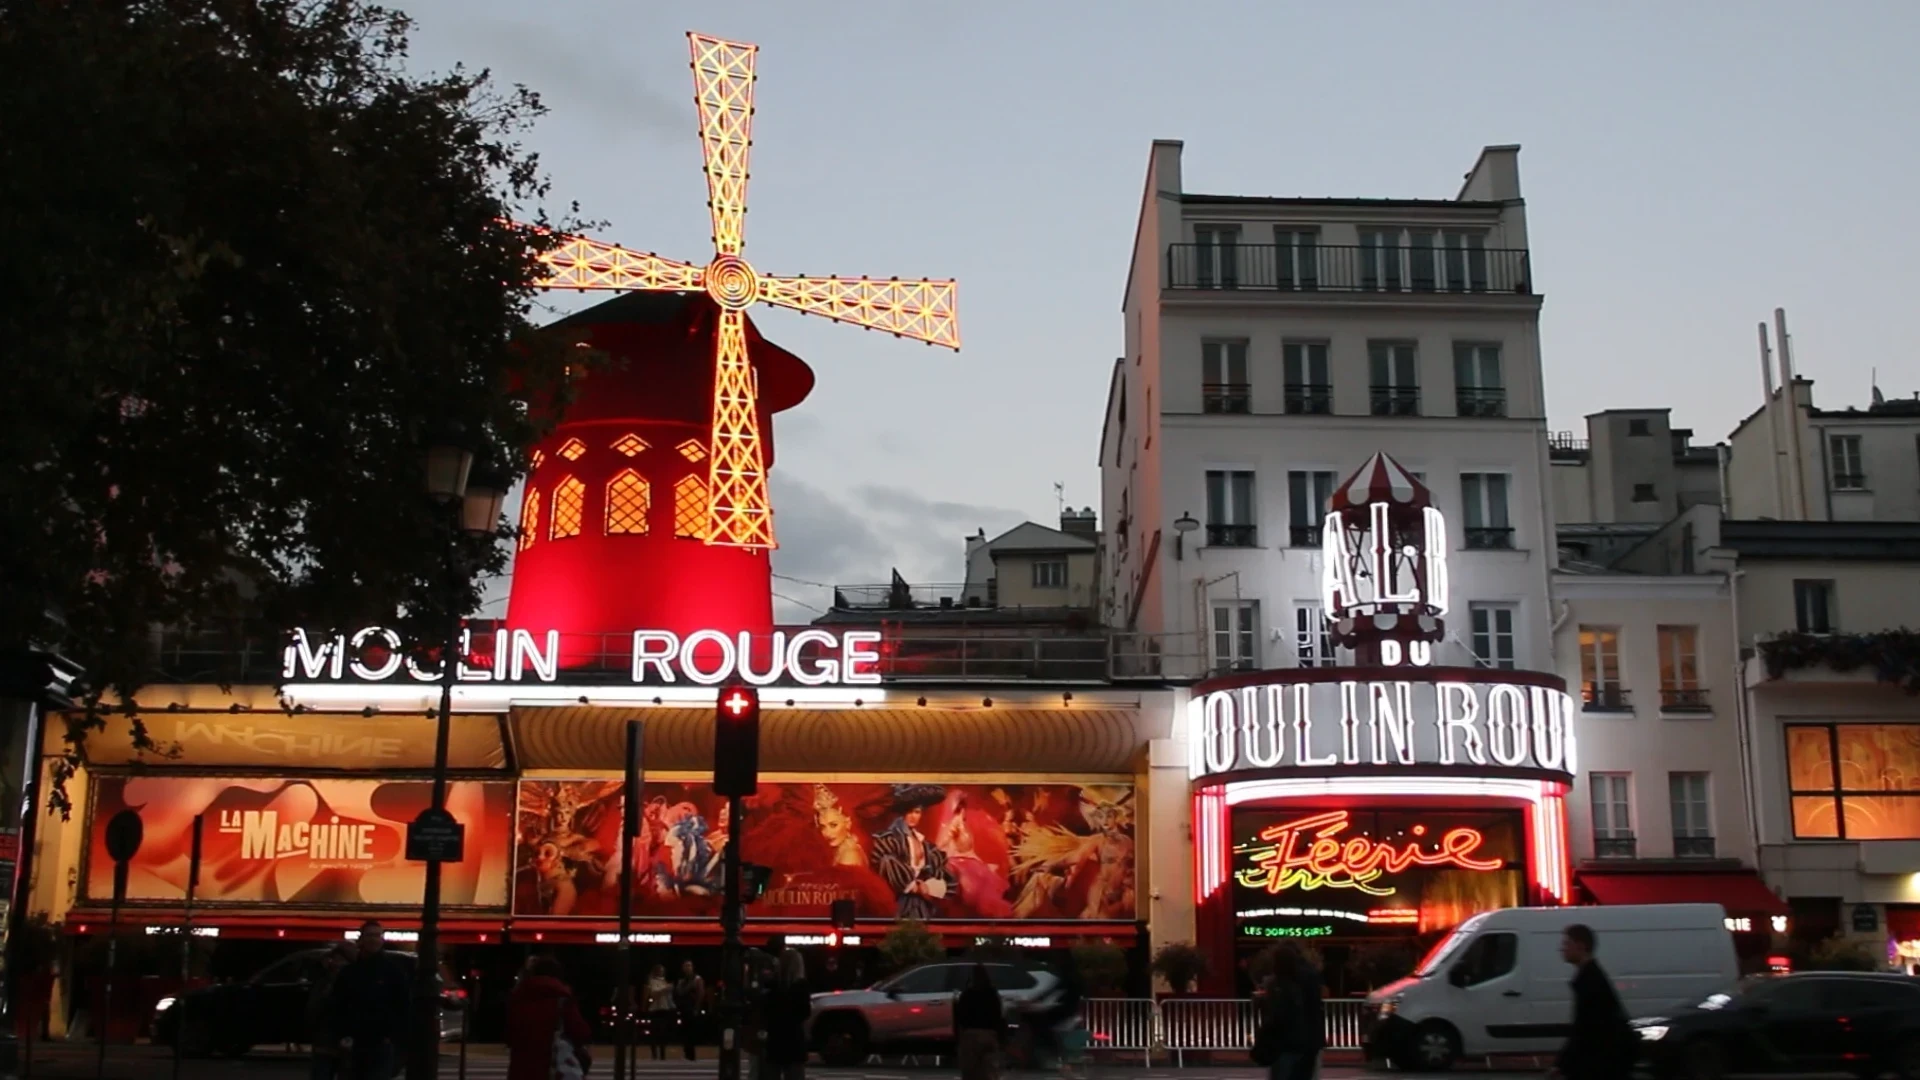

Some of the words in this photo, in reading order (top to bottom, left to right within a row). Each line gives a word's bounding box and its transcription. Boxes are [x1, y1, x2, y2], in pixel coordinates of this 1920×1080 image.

[632, 629, 882, 686] ROUGE
[1380, 639, 1431, 667] DU
[220, 811, 242, 827] LA
[1261, 810, 1504, 894] Féerie
